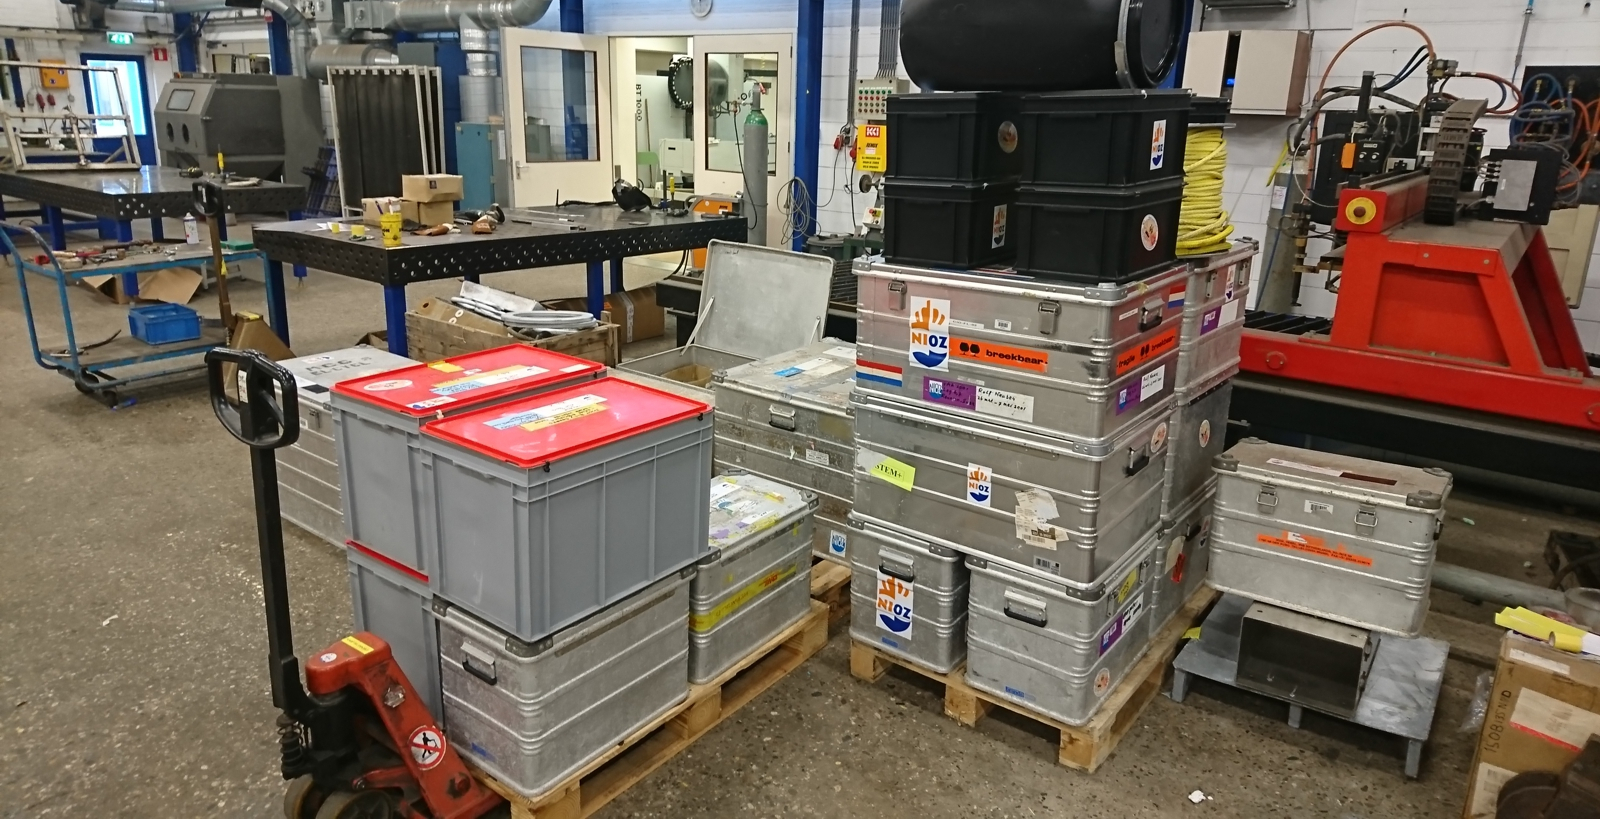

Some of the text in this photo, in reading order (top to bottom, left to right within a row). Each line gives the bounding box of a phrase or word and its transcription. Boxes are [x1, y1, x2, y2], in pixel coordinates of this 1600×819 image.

[635, 83, 643, 122] BT 1000
[911, 331, 948, 349] NIOZ
[968, 481, 990, 494] NIOZ
[877, 597, 912, 620] NIOZ
